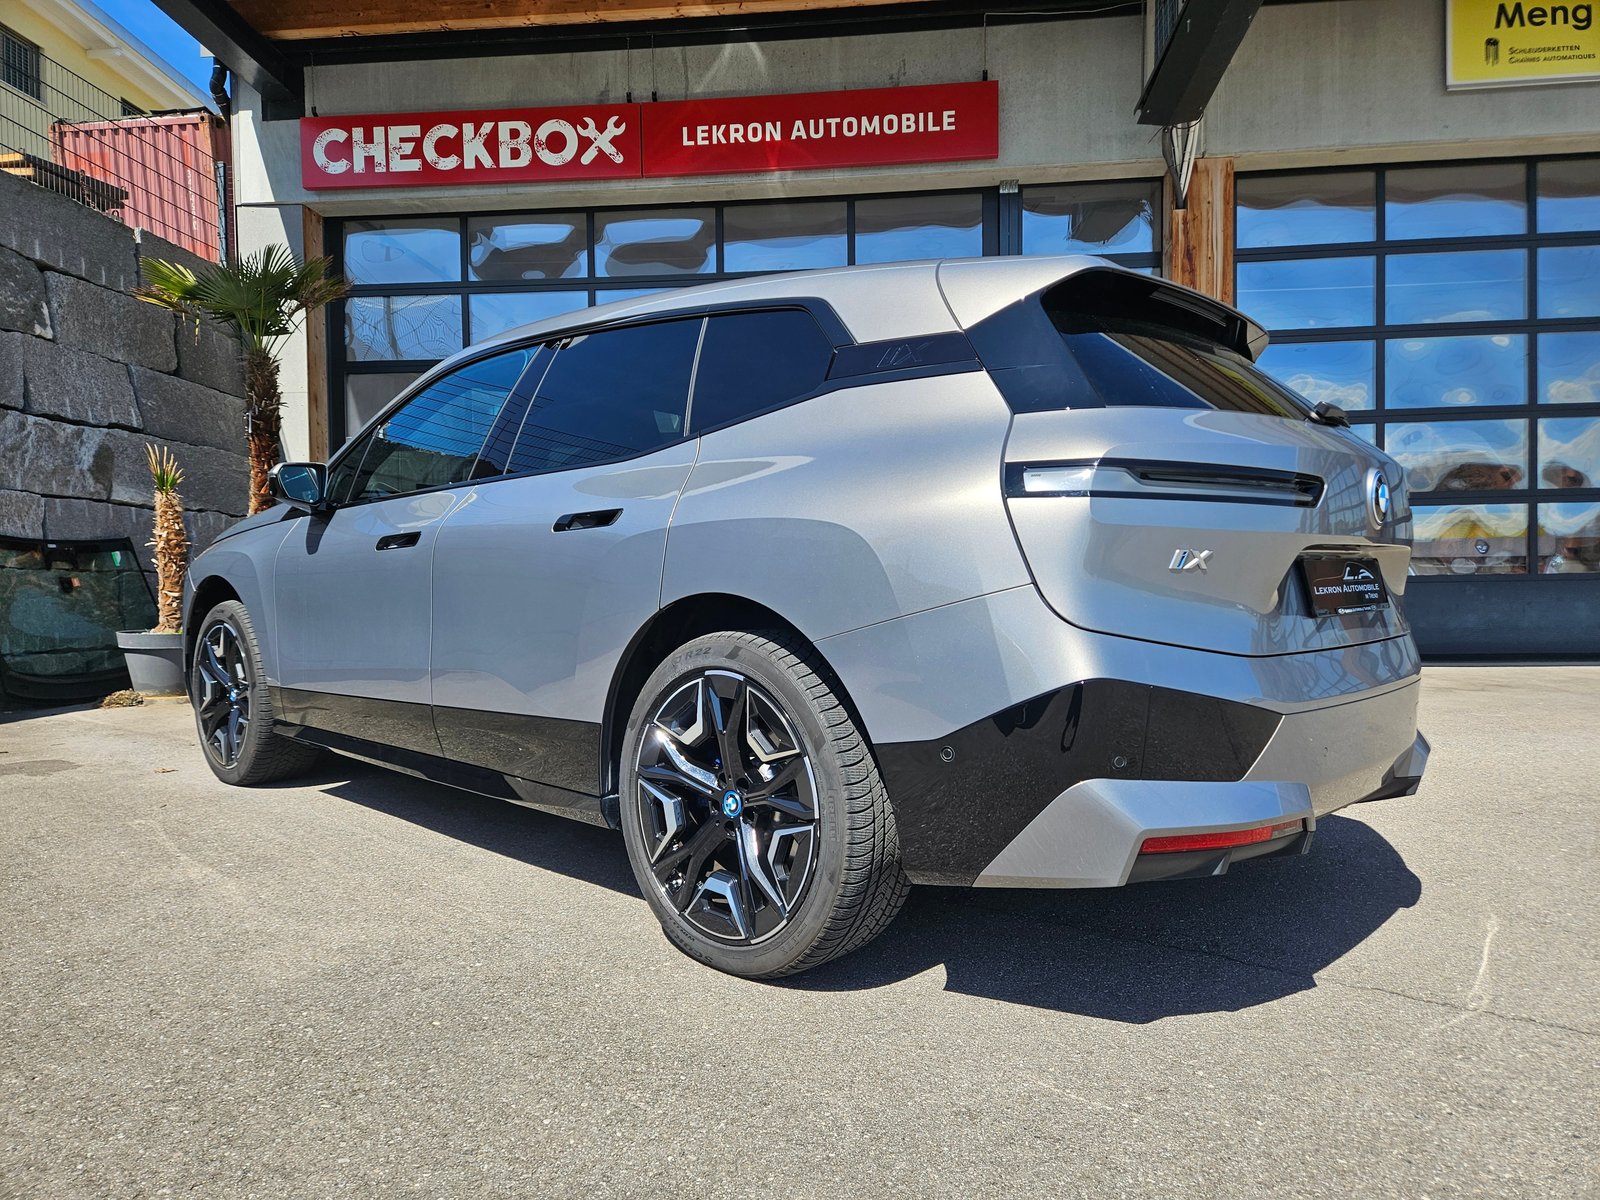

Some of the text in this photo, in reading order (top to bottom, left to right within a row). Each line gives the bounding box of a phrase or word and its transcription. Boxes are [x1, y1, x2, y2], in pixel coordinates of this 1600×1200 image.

[1495, 2, 1593, 31] Meng
[1508, 45, 1581, 55] SCHLEUDERKETTEN
[1542, 53, 1596, 63] AUTOMATIQUES
[681, 110, 957, 147] LEKRON AUTOMOBILE
[312, 115, 627, 175] CHECKBOX
[1168, 548, 1213, 570] iX
[1313, 583, 1380, 595] LEKRON AUTOMOBILE
